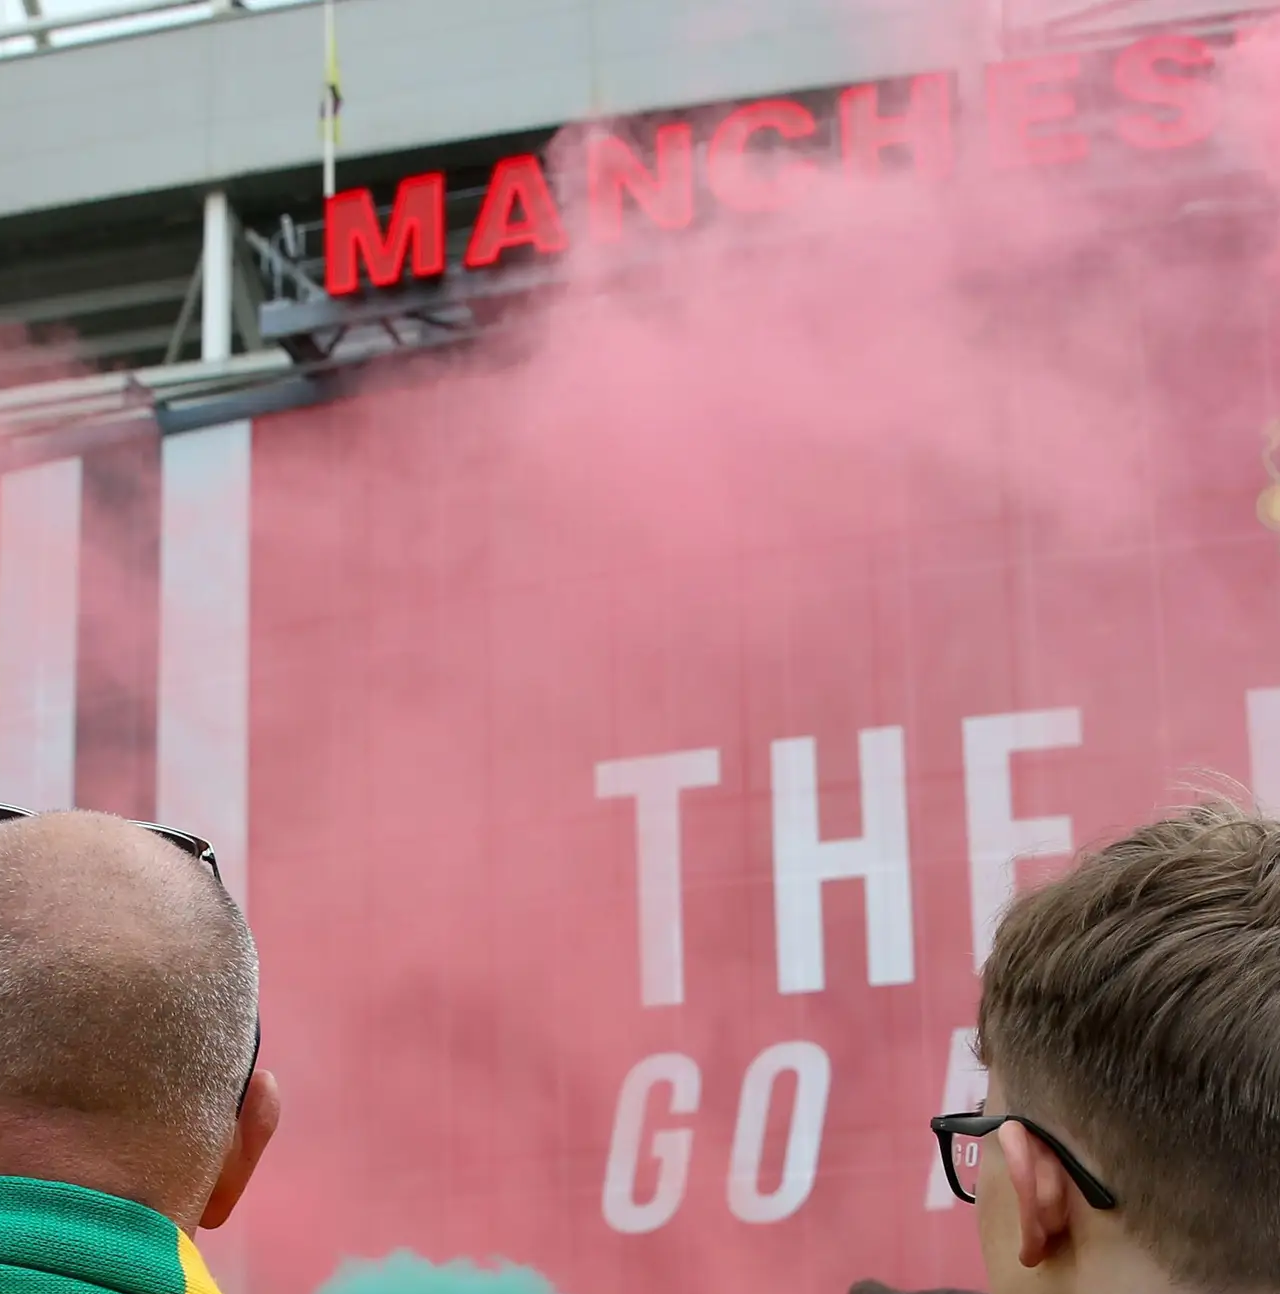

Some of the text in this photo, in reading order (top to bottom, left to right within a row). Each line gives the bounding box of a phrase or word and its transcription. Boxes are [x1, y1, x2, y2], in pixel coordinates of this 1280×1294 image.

[325, 33, 1216, 296] MANCHES
[595, 706, 1083, 1009] THE
[601, 1040, 831, 1233] GO
